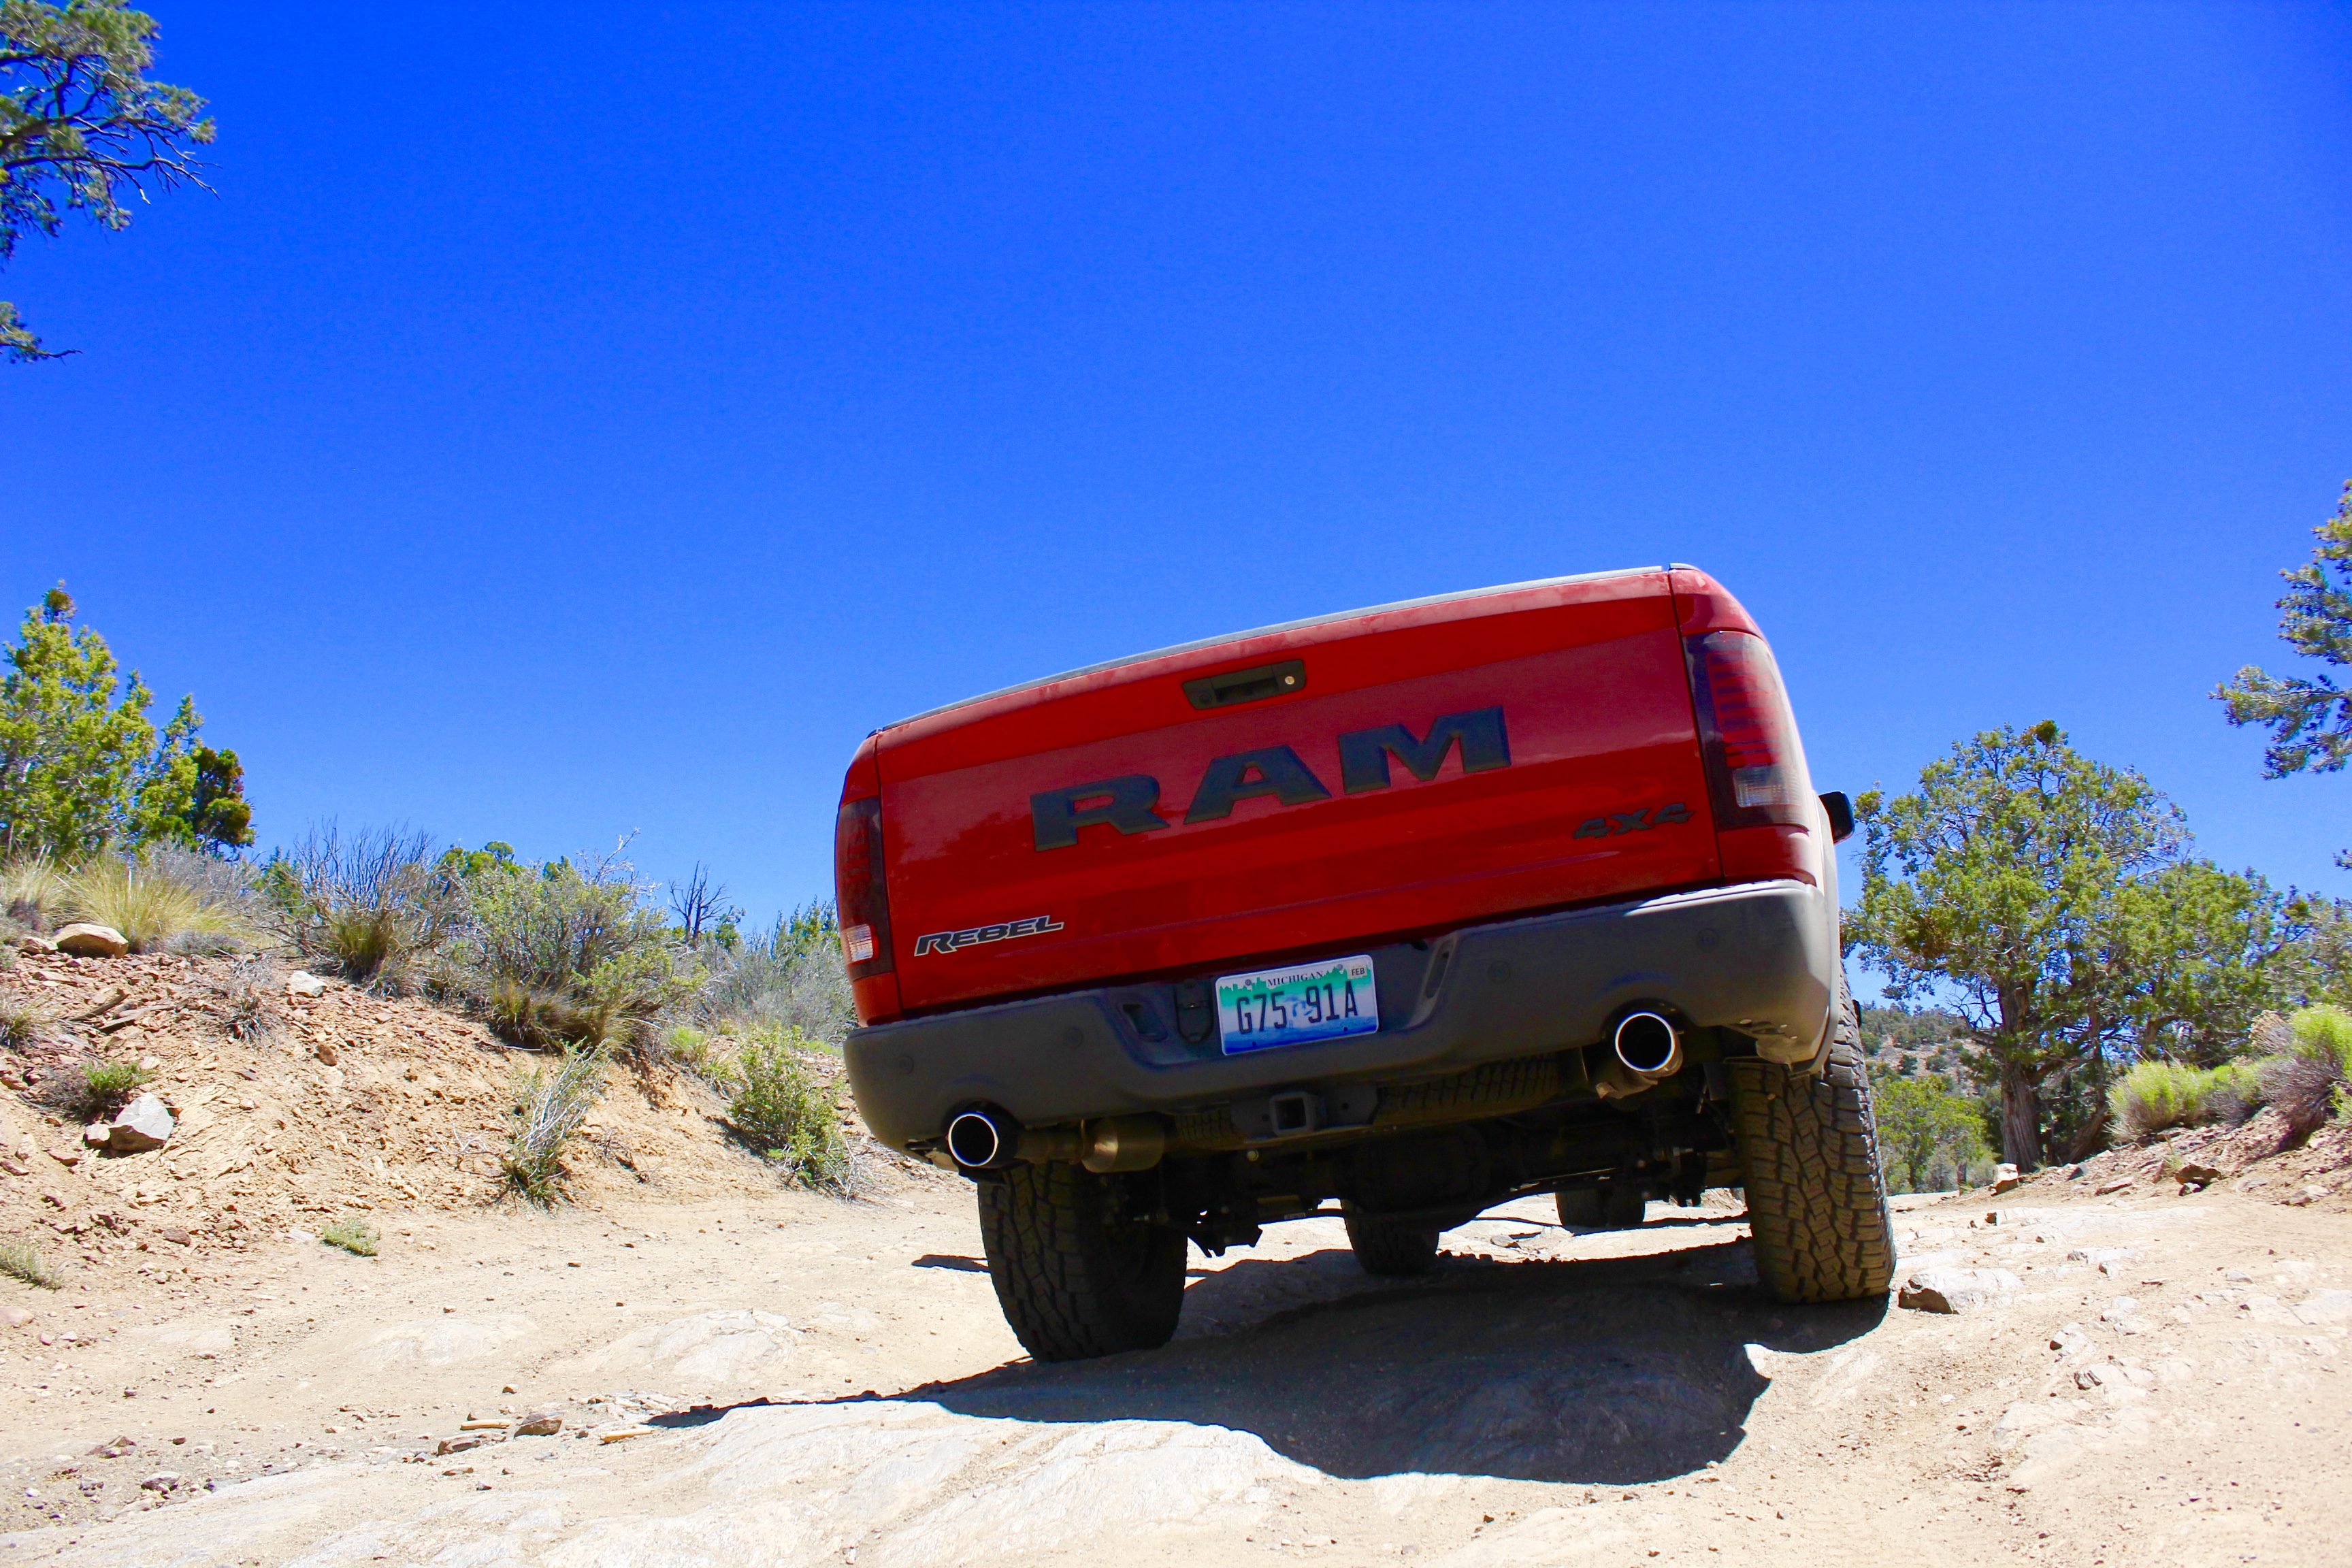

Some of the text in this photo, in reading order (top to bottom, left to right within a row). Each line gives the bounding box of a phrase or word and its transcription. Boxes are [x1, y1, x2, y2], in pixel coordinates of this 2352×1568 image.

[1030, 705, 1511, 852] RAM
[914, 915, 1064, 957] REBEL
[1267, 970, 1324, 987] MICHIGAN
[1351, 967, 1365, 976] FEB
